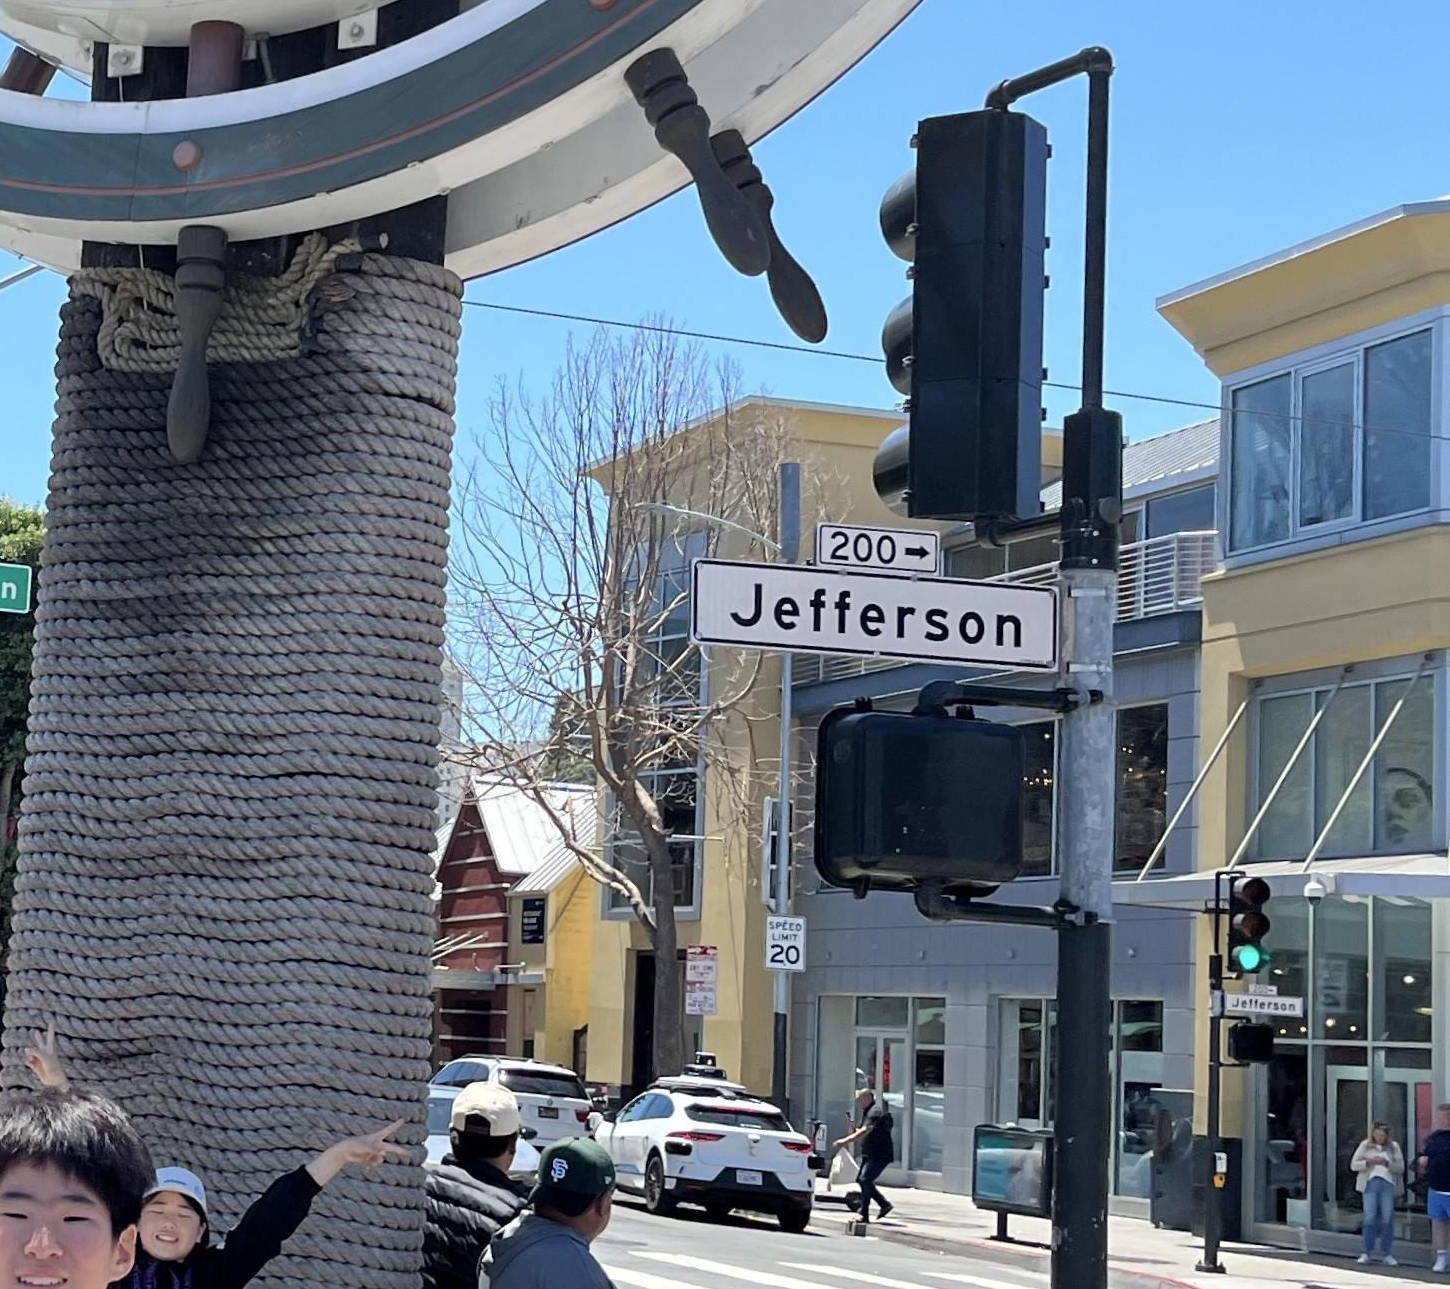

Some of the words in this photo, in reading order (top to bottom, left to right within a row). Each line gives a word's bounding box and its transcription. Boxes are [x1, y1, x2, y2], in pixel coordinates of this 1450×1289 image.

[829, 531, 897, 565] 200
[729, 583, 1022, 648] Jefferson
[768, 920, 803, 931] SPEED
[772, 933, 798, 941] LIMIT
[770, 944, 800, 965] 20
[1231, 998, 1296, 1012] Jefferson
